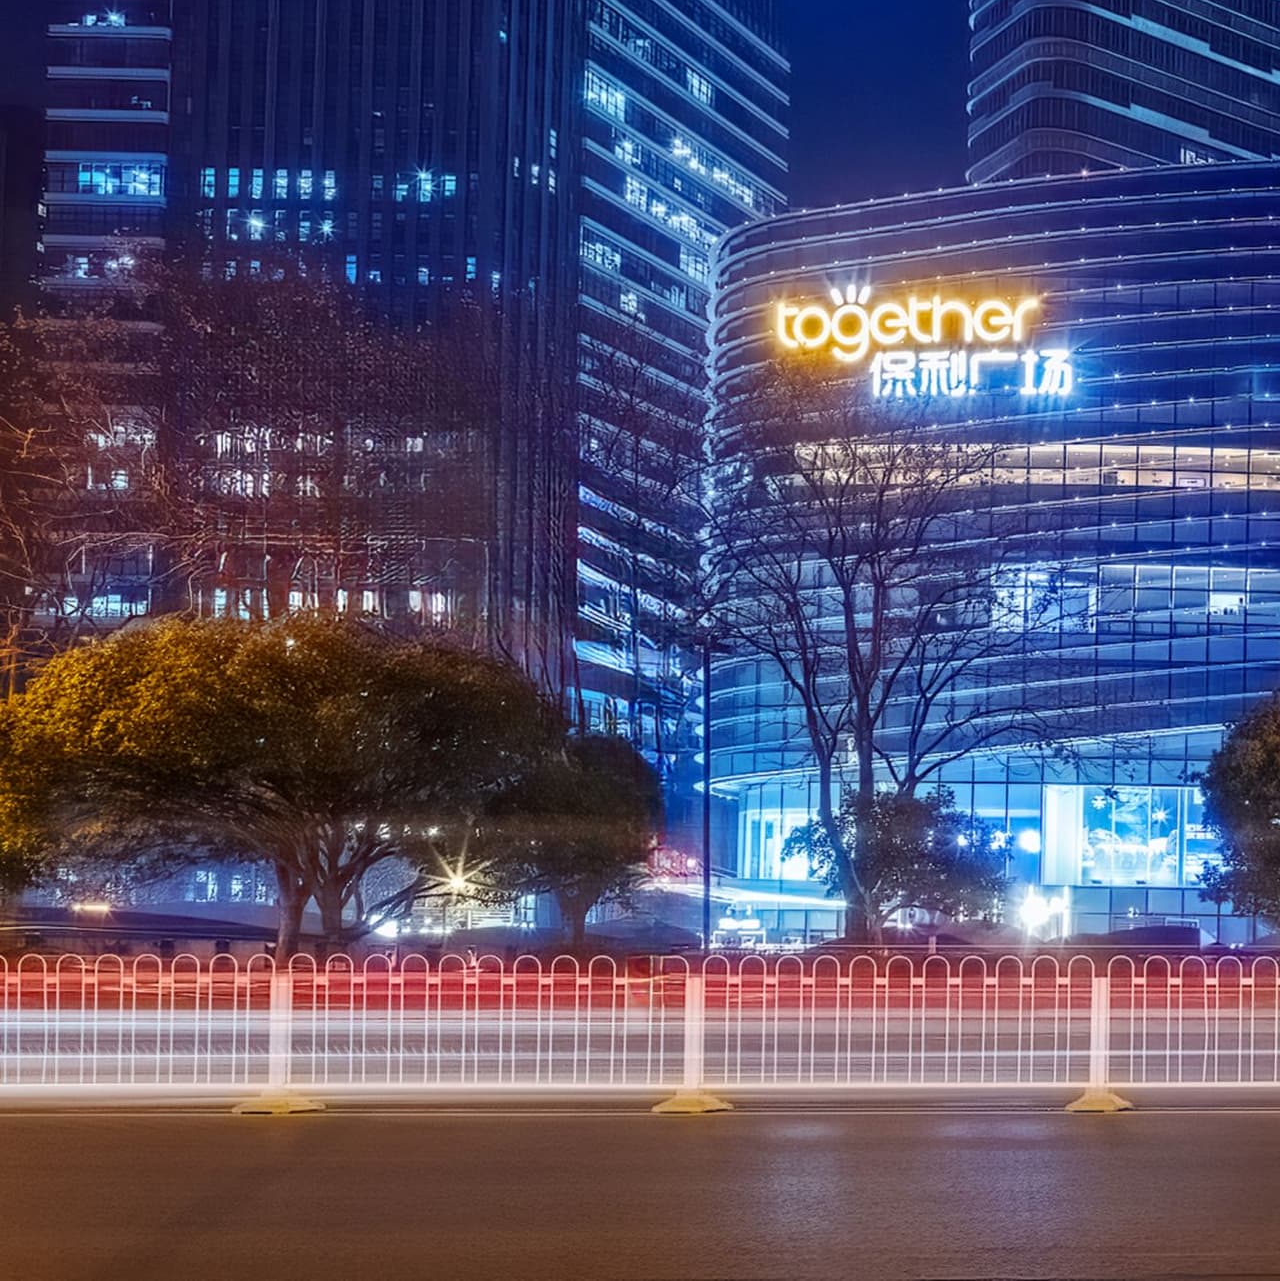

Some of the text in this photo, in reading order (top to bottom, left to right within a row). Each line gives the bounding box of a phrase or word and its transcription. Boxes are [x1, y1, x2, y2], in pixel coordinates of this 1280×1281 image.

[777, 295, 1039, 362] together
[870, 349, 1073, 397] 保利广场
